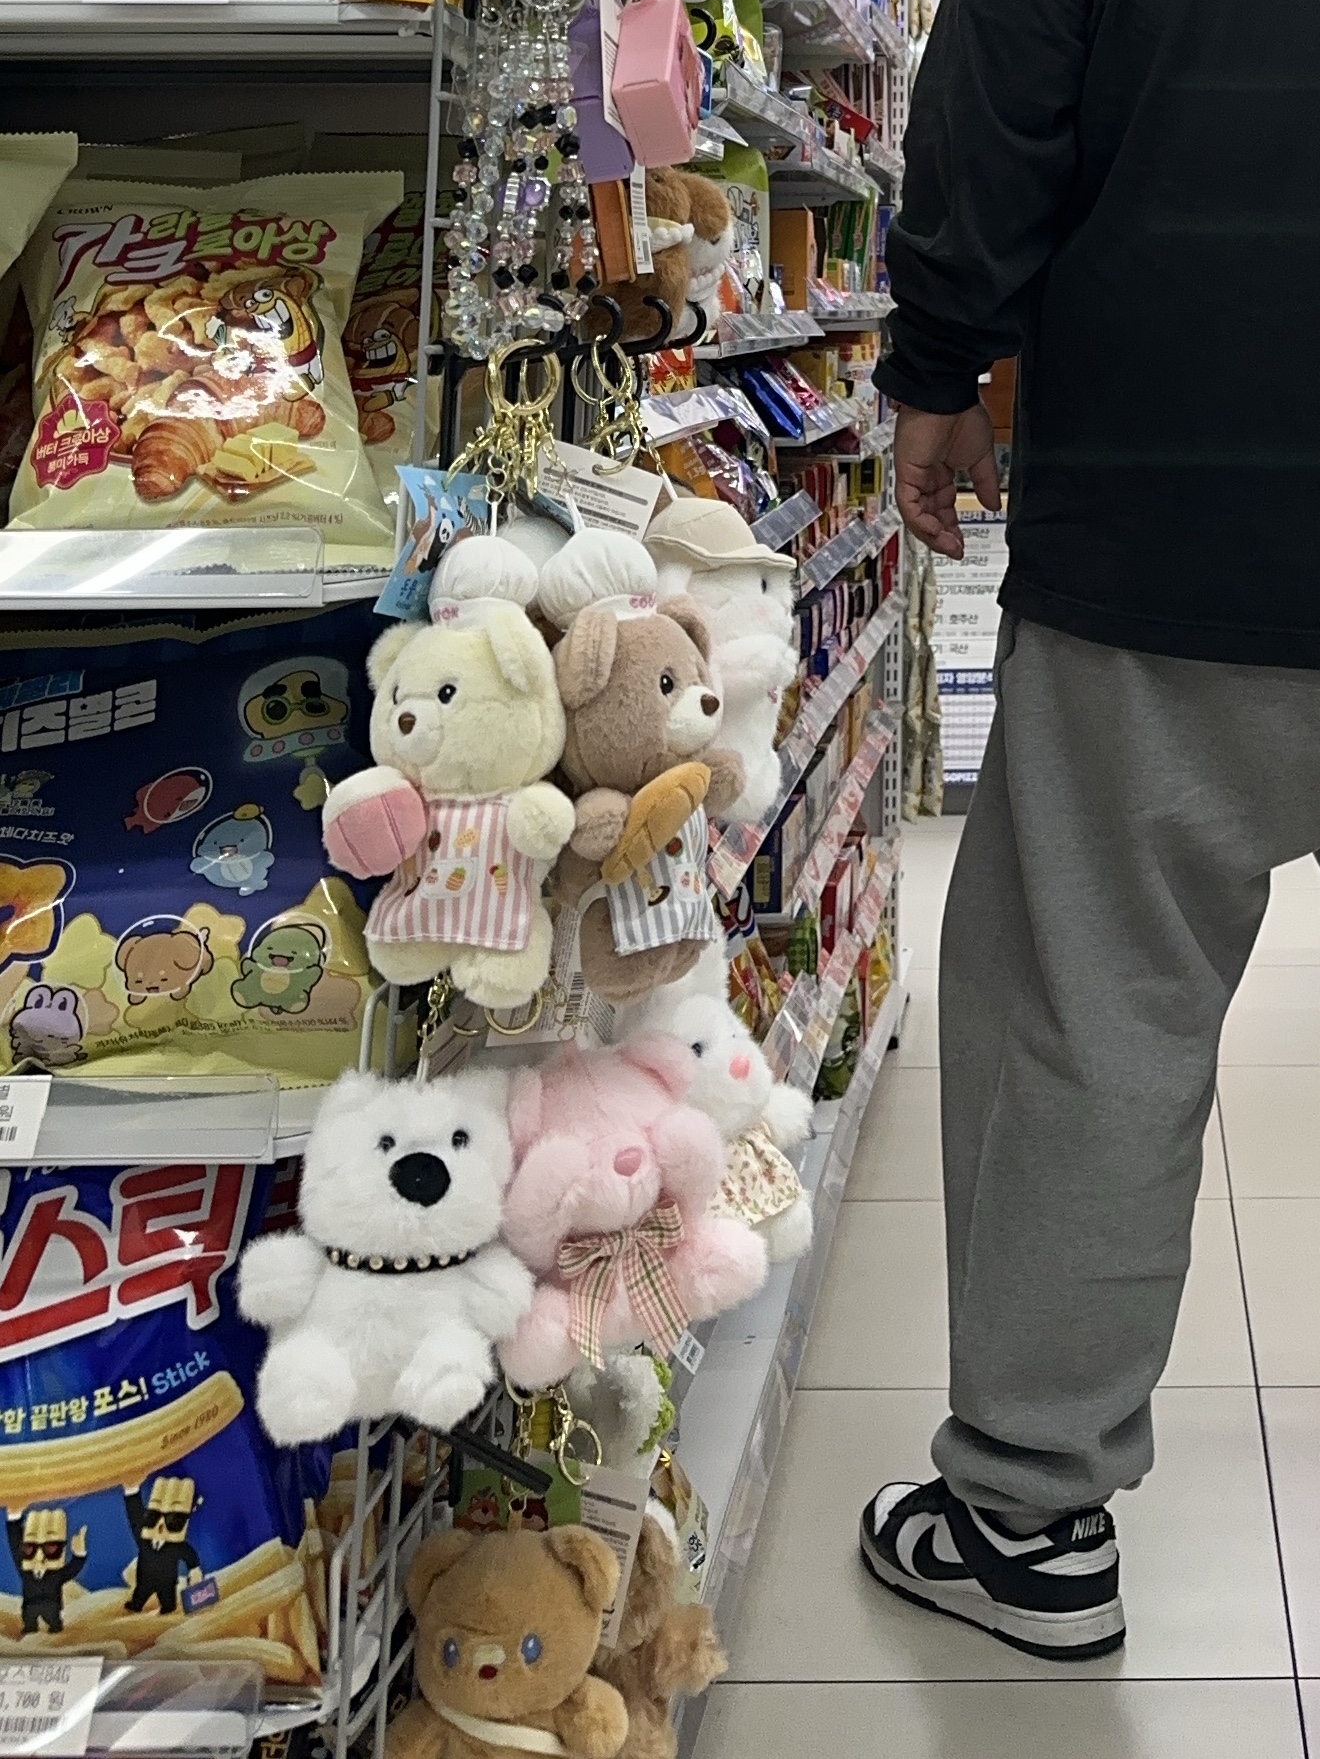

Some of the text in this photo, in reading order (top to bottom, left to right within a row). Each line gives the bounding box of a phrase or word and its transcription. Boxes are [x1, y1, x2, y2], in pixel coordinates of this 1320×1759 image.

[31, 1395, 88, 1431] 끝판왕
[94, 1376, 150, 1418] 포스!
[152, 1351, 211, 1395] Stick
[1071, 1511, 1106, 1542] NIKE
